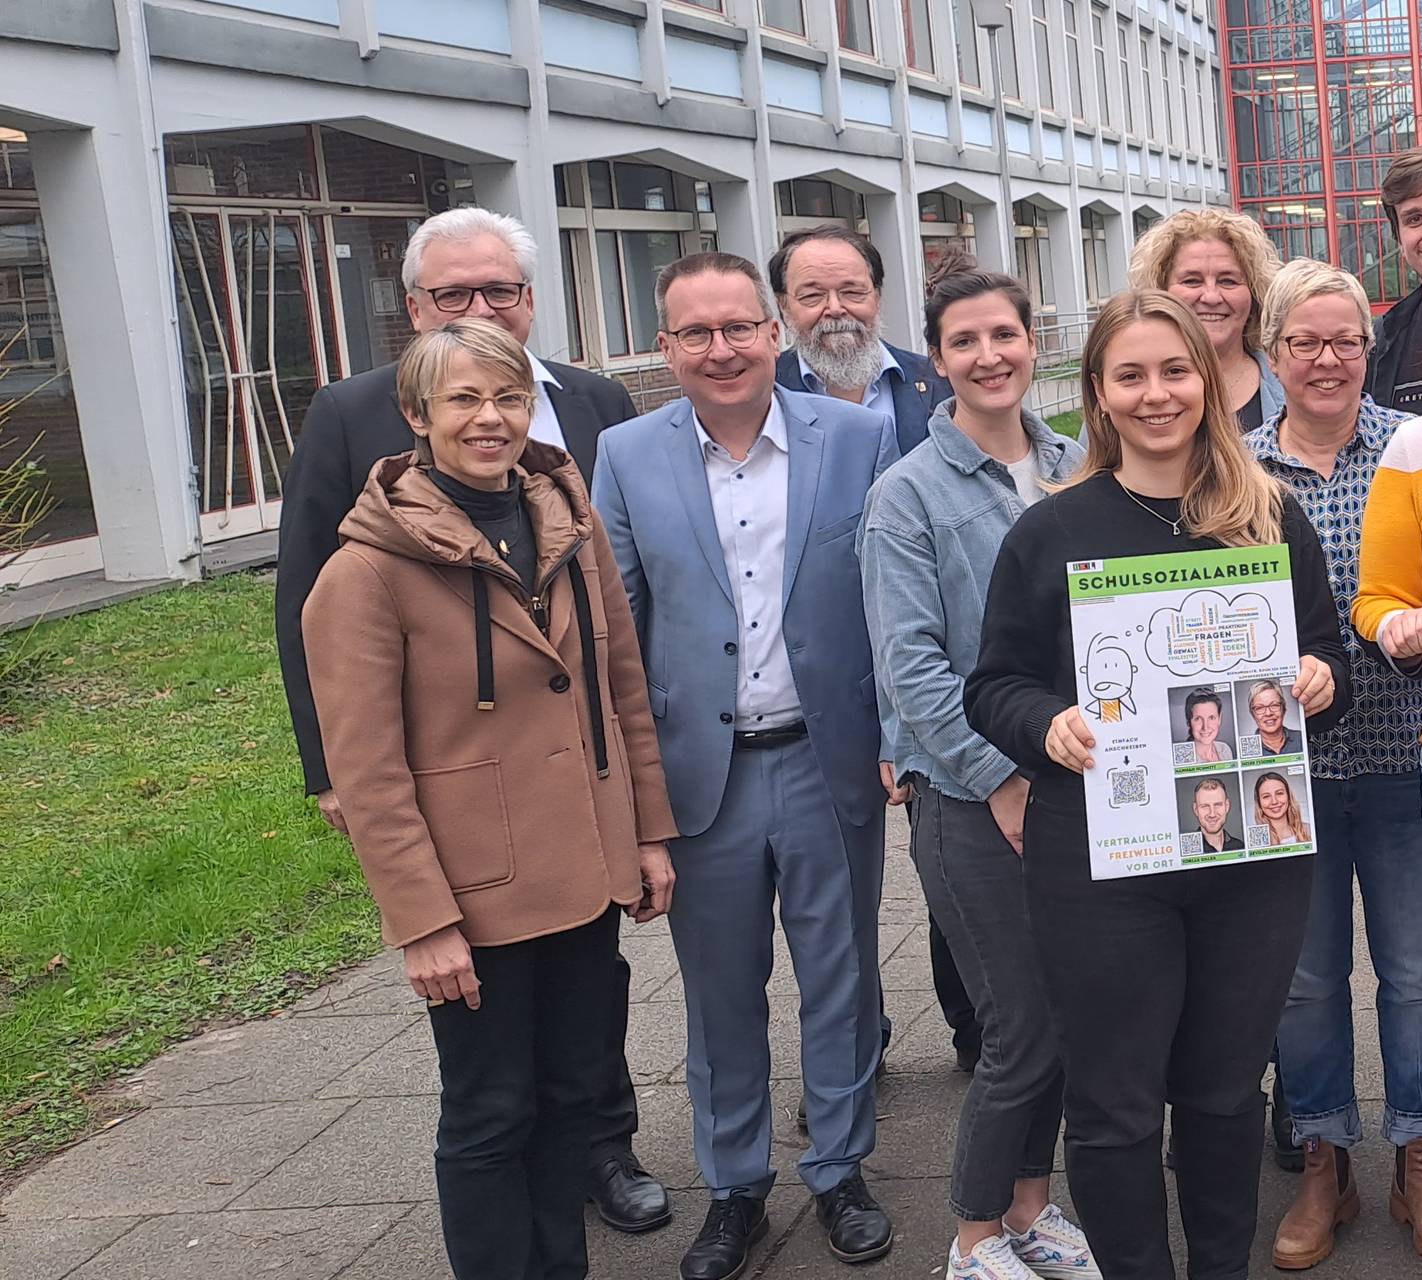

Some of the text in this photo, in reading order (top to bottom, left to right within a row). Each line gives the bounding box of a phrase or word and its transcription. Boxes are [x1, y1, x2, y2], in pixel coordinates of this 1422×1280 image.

[1078, 561, 1280, 591] SCHULSOZIALARBEIT
[1195, 631, 1232, 641] FRAGEN
[1173, 647, 1197, 655] GEWALT
[1096, 832, 1172, 848] VERTRAULICH
[1109, 846, 1173, 860] FREIWILLIG
[1126, 862, 1149, 872] VOR
[1153, 859, 1174, 869] ORT
